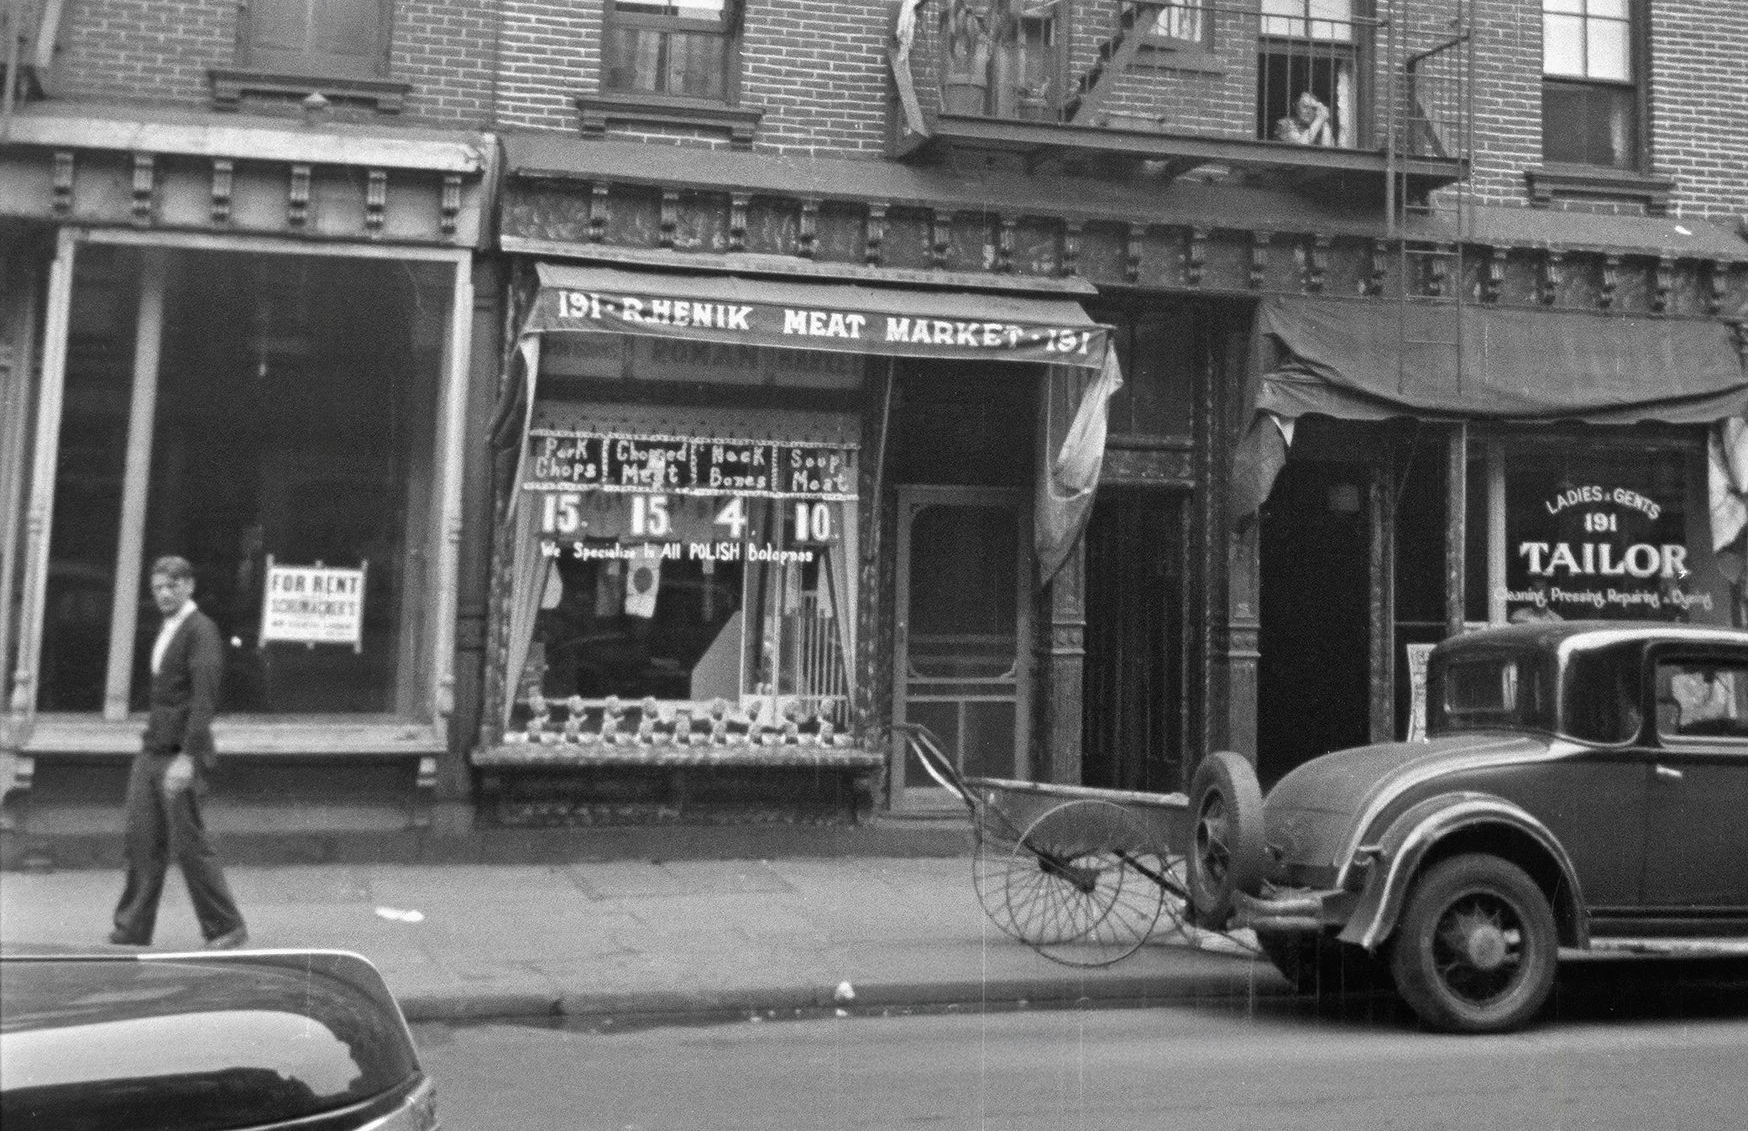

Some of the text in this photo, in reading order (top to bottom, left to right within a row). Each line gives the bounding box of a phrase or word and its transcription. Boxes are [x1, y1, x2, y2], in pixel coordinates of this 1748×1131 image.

[558, 291, 602, 318] 191
[783, 309, 866, 338] MEAT
[885, 318, 1024, 349] MARKET
[1045, 329, 1090, 354] 191
[536, 456, 597, 481] Chops
[791, 448, 839, 474] Soup
[709, 466, 767, 488] Bones
[792, 470, 849, 492] Meat
[1546, 485, 1603, 515] LADIES
[1613, 487, 1661, 520] GENTS
[1584, 512, 1618, 532] 191
[540, 541, 561, 557] We
[659, 542, 681, 560] All
[689, 542, 740, 561] POLISH
[1519, 541, 1690, 578] TAILOR
[272, 574, 357, 594] FOR RENT
